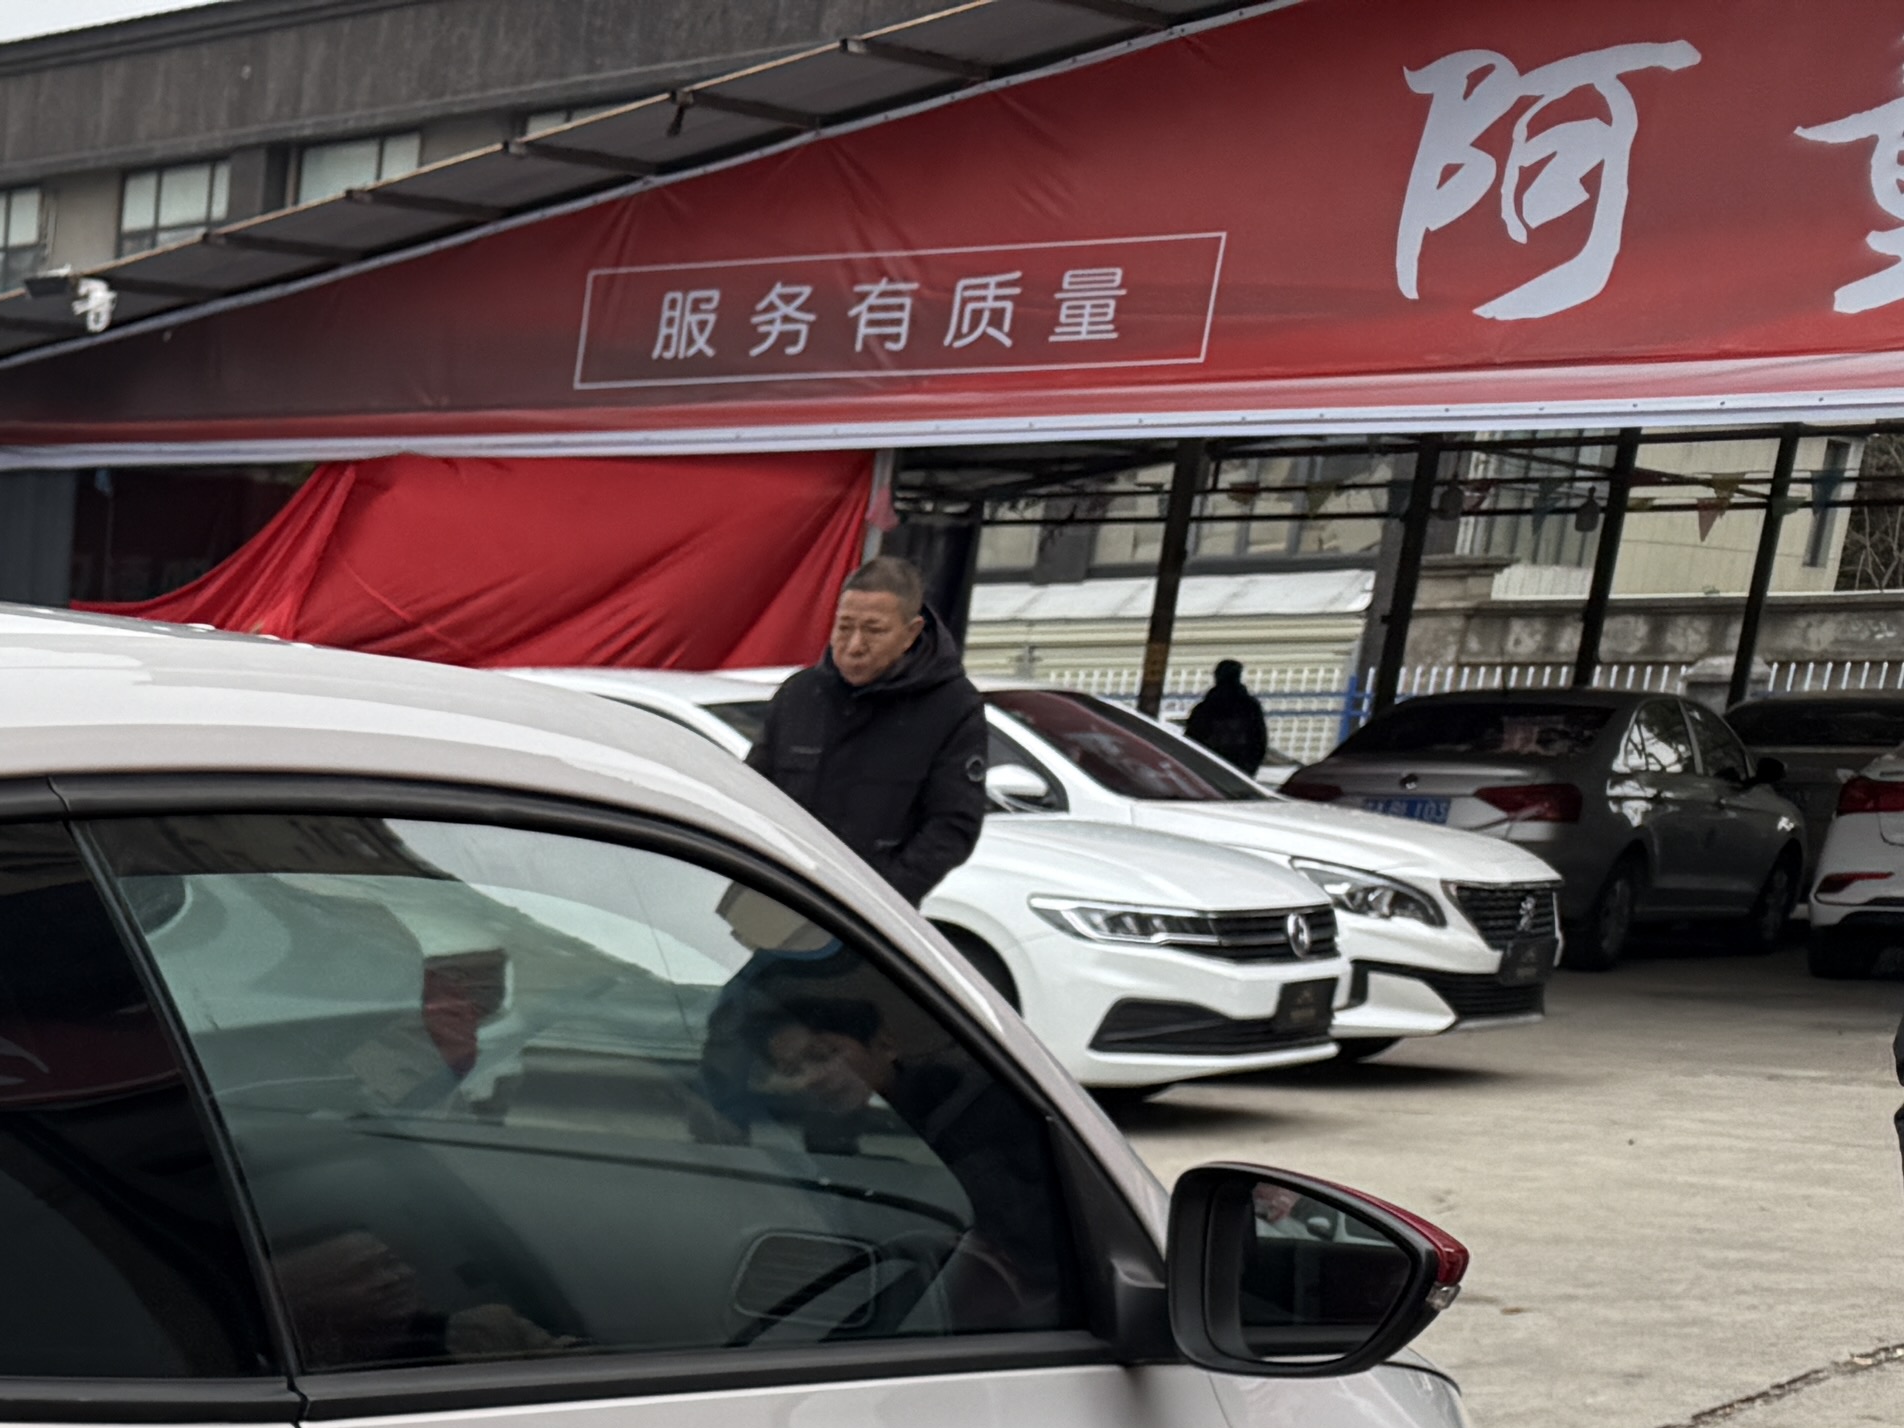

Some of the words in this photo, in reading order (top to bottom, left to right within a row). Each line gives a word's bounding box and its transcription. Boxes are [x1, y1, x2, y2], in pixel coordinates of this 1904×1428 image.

[651, 267, 1127, 360] 服务有质量
